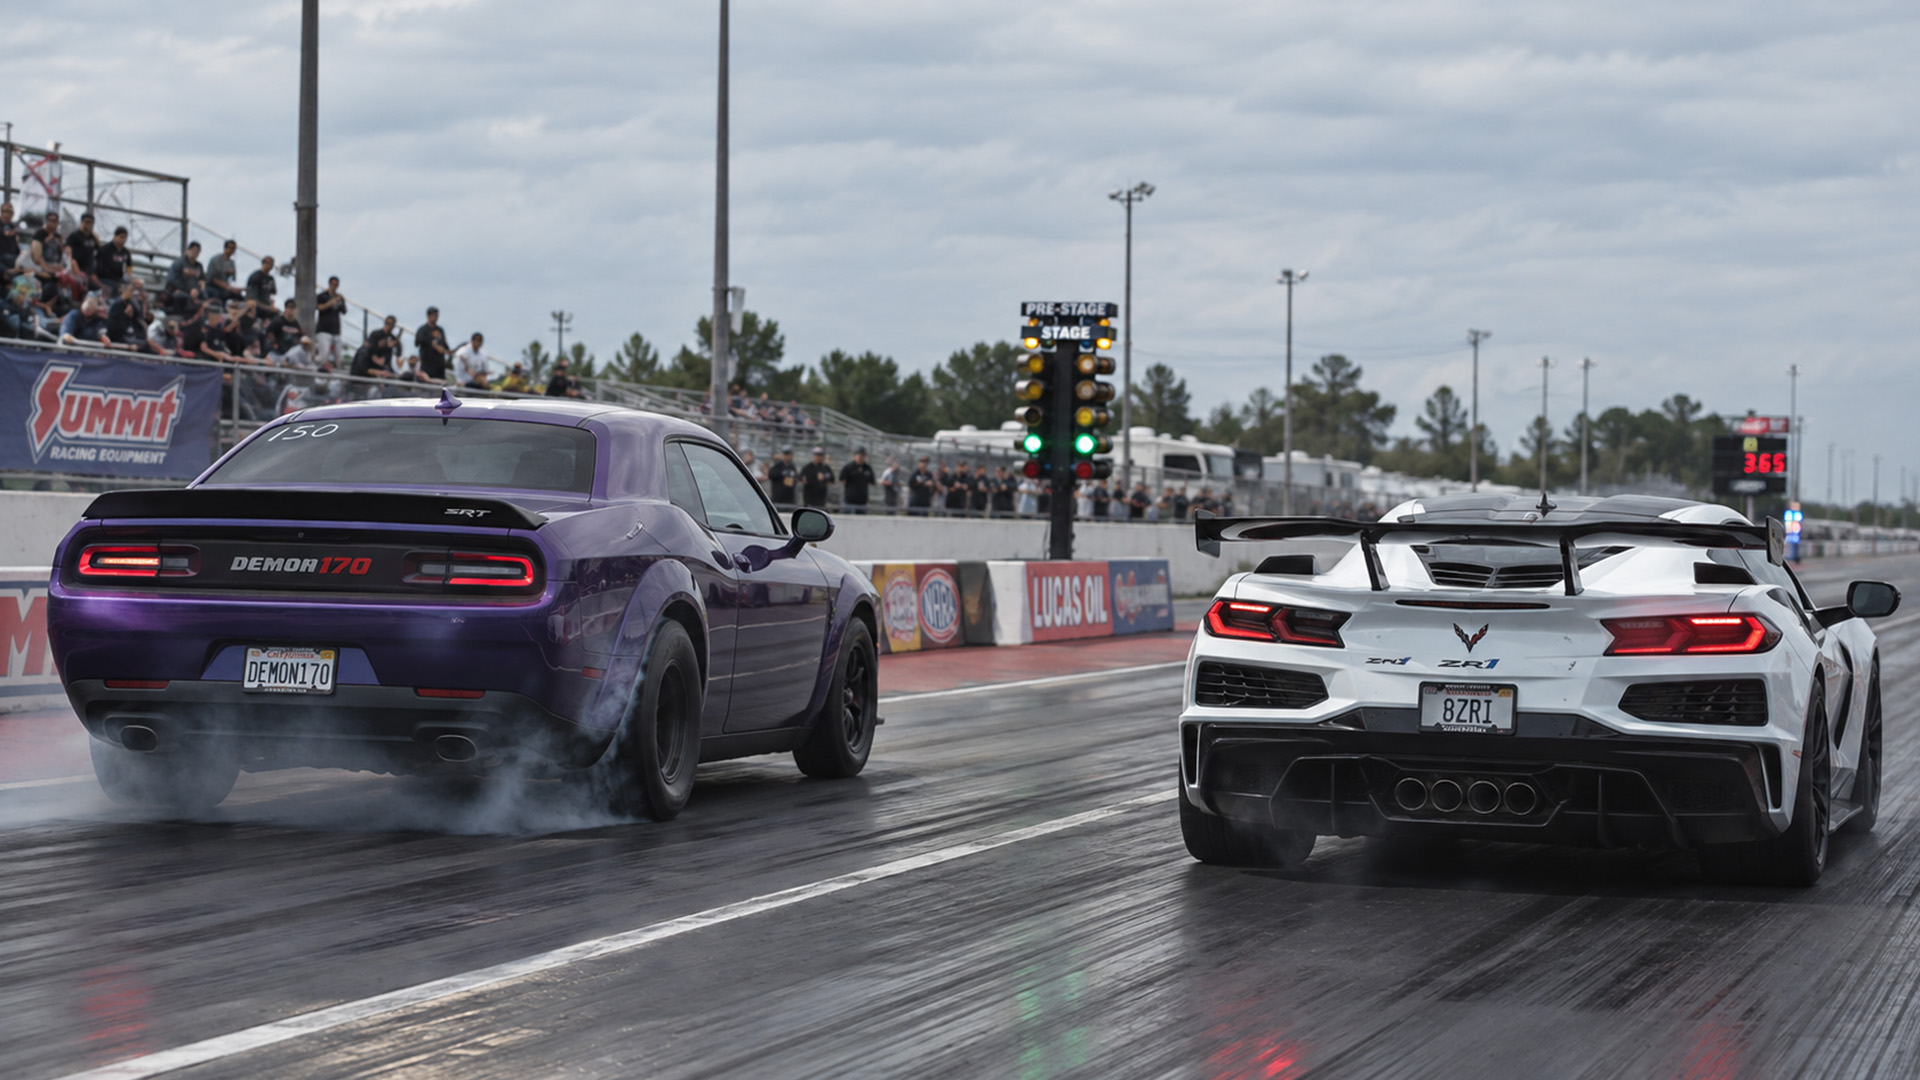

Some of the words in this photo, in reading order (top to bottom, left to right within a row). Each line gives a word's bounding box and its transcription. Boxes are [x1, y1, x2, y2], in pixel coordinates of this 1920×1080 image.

[1026, 302, 1107, 315] PRE-STAGE
[1041, 326, 1091, 339] STAGE
[268, 424, 339, 441] 150
[50, 446, 97, 461] RACING
[99, 449, 167, 464] EQUIPMENT
[444, 508, 492, 518] SRT
[1033, 575, 1082, 628] LUCAS
[1084, 575, 1108, 624] OIL
[1437, 658, 1500, 669] ZR1
[247, 661, 330, 685] DEMON170
